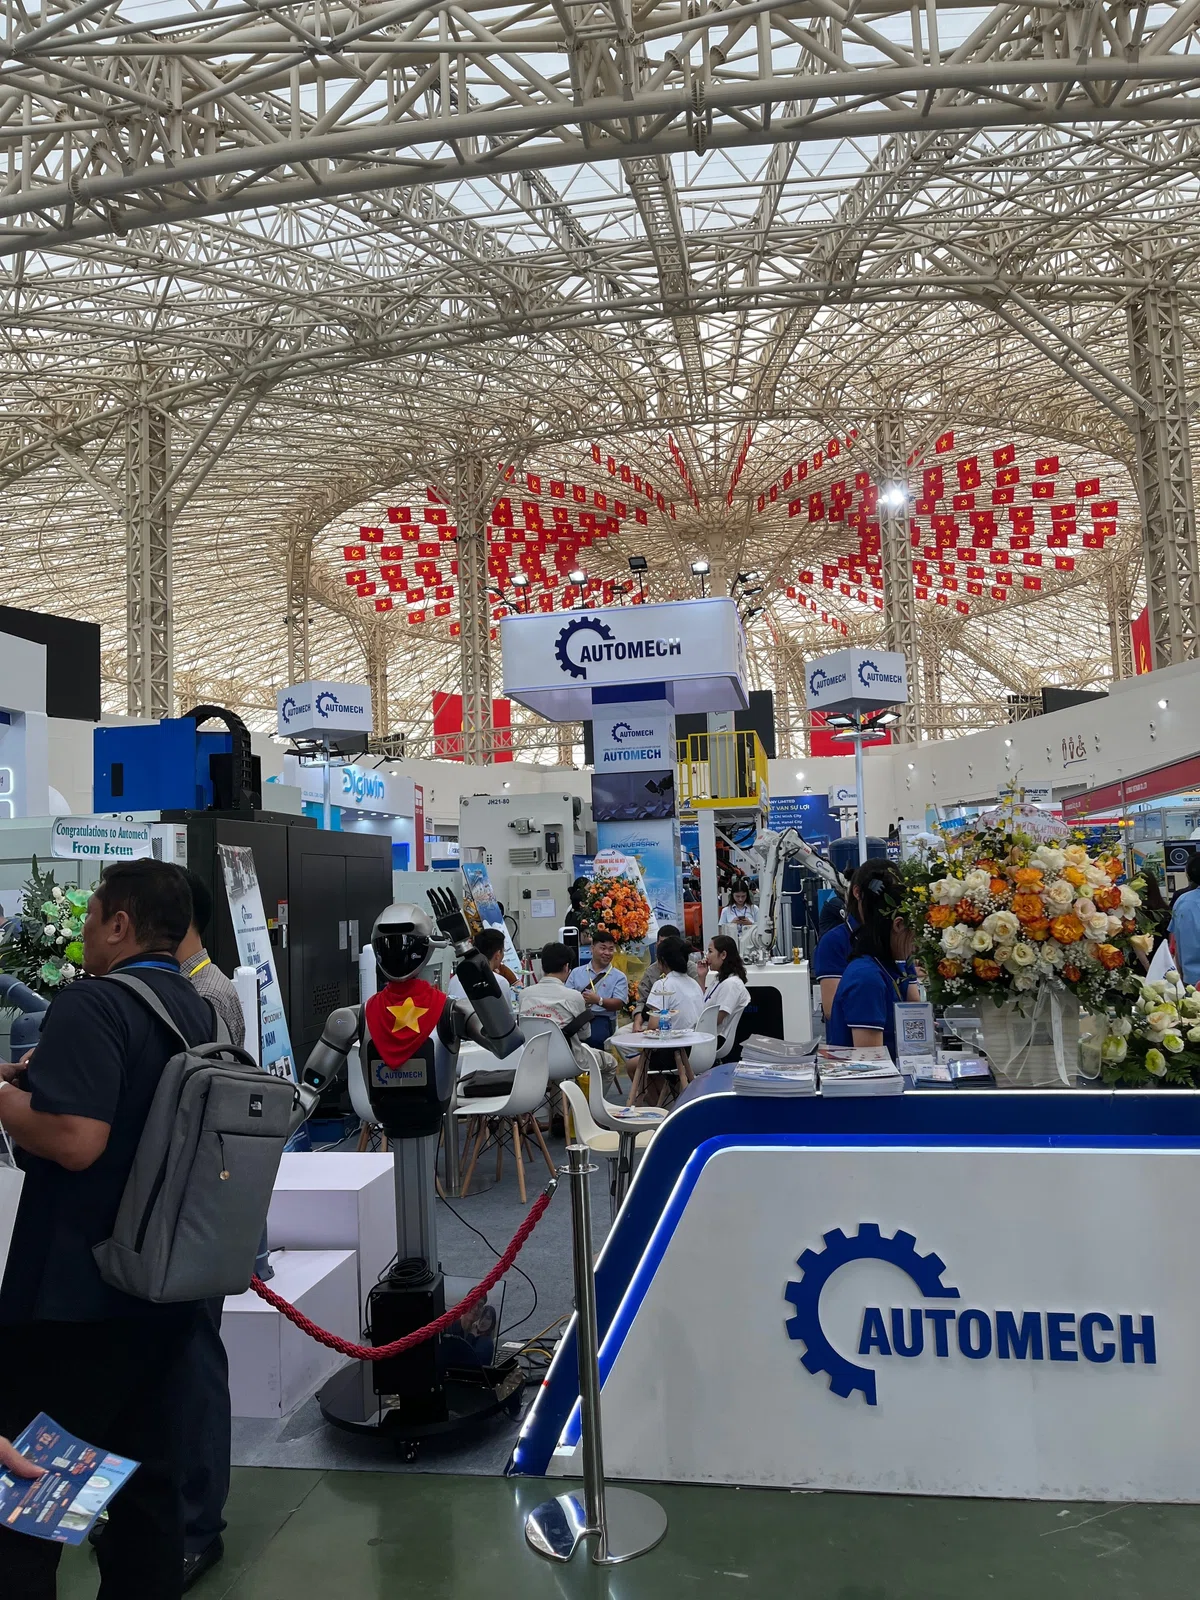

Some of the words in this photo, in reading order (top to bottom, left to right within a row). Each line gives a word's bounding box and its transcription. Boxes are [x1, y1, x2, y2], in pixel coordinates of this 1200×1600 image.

[580, 637, 682, 663] AUTOMECH
[816, 673, 847, 689] AUTOMECH
[866, 672, 903, 684] AUTOMECH
[287, 703, 312, 717] AUTOMECH
[325, 703, 364, 714] AUTOMECH
[619, 729, 654, 738] AUTOMECH
[603, 748, 662, 762] AUTOMECH
[342, 767, 385, 803] Digiwin
[56, 822, 108, 838] Congratulations
[109, 828, 117, 838] to
[118, 826, 148, 840] Automech
[72, 841, 101, 855] From
[103, 842, 134, 856] Estun
[384, 1070, 423, 1080] AUTOMECH
[857, 1305, 1157, 1365] AUTOMECH
